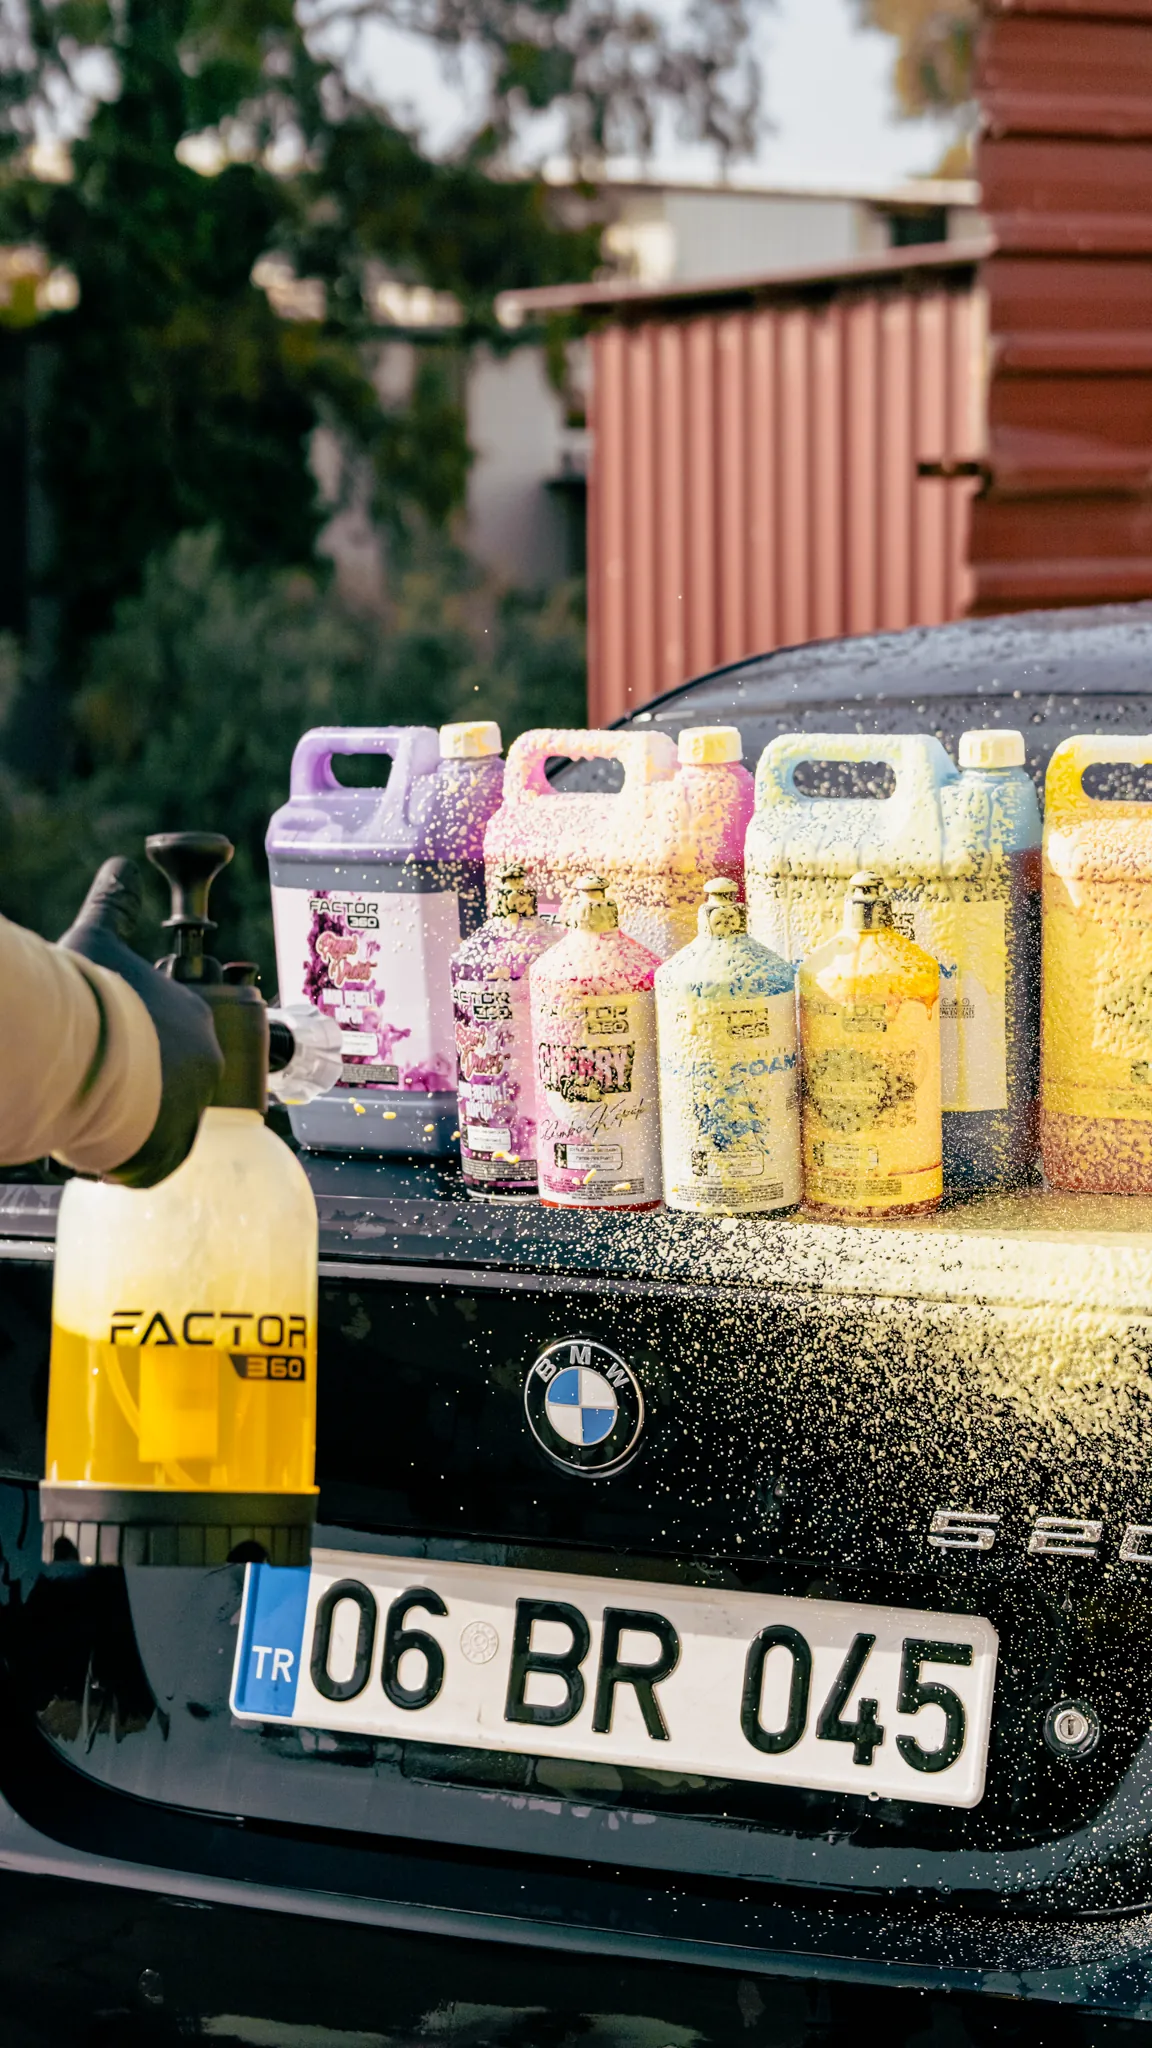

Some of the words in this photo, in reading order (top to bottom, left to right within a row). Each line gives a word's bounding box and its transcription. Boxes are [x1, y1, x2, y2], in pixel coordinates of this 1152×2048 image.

[309, 900, 379, 915] FACTOR
[348, 915, 380, 929] 360
[110, 1311, 307, 1347] FACTOR
[243, 1355, 305, 1380] 360
[535, 1346, 630, 1388] BMW
[251, 1644, 294, 1683] TR
[311, 1579, 448, 1710] 06
[505, 1598, 680, 1741] BR
[740, 1624, 973, 1773] 045
